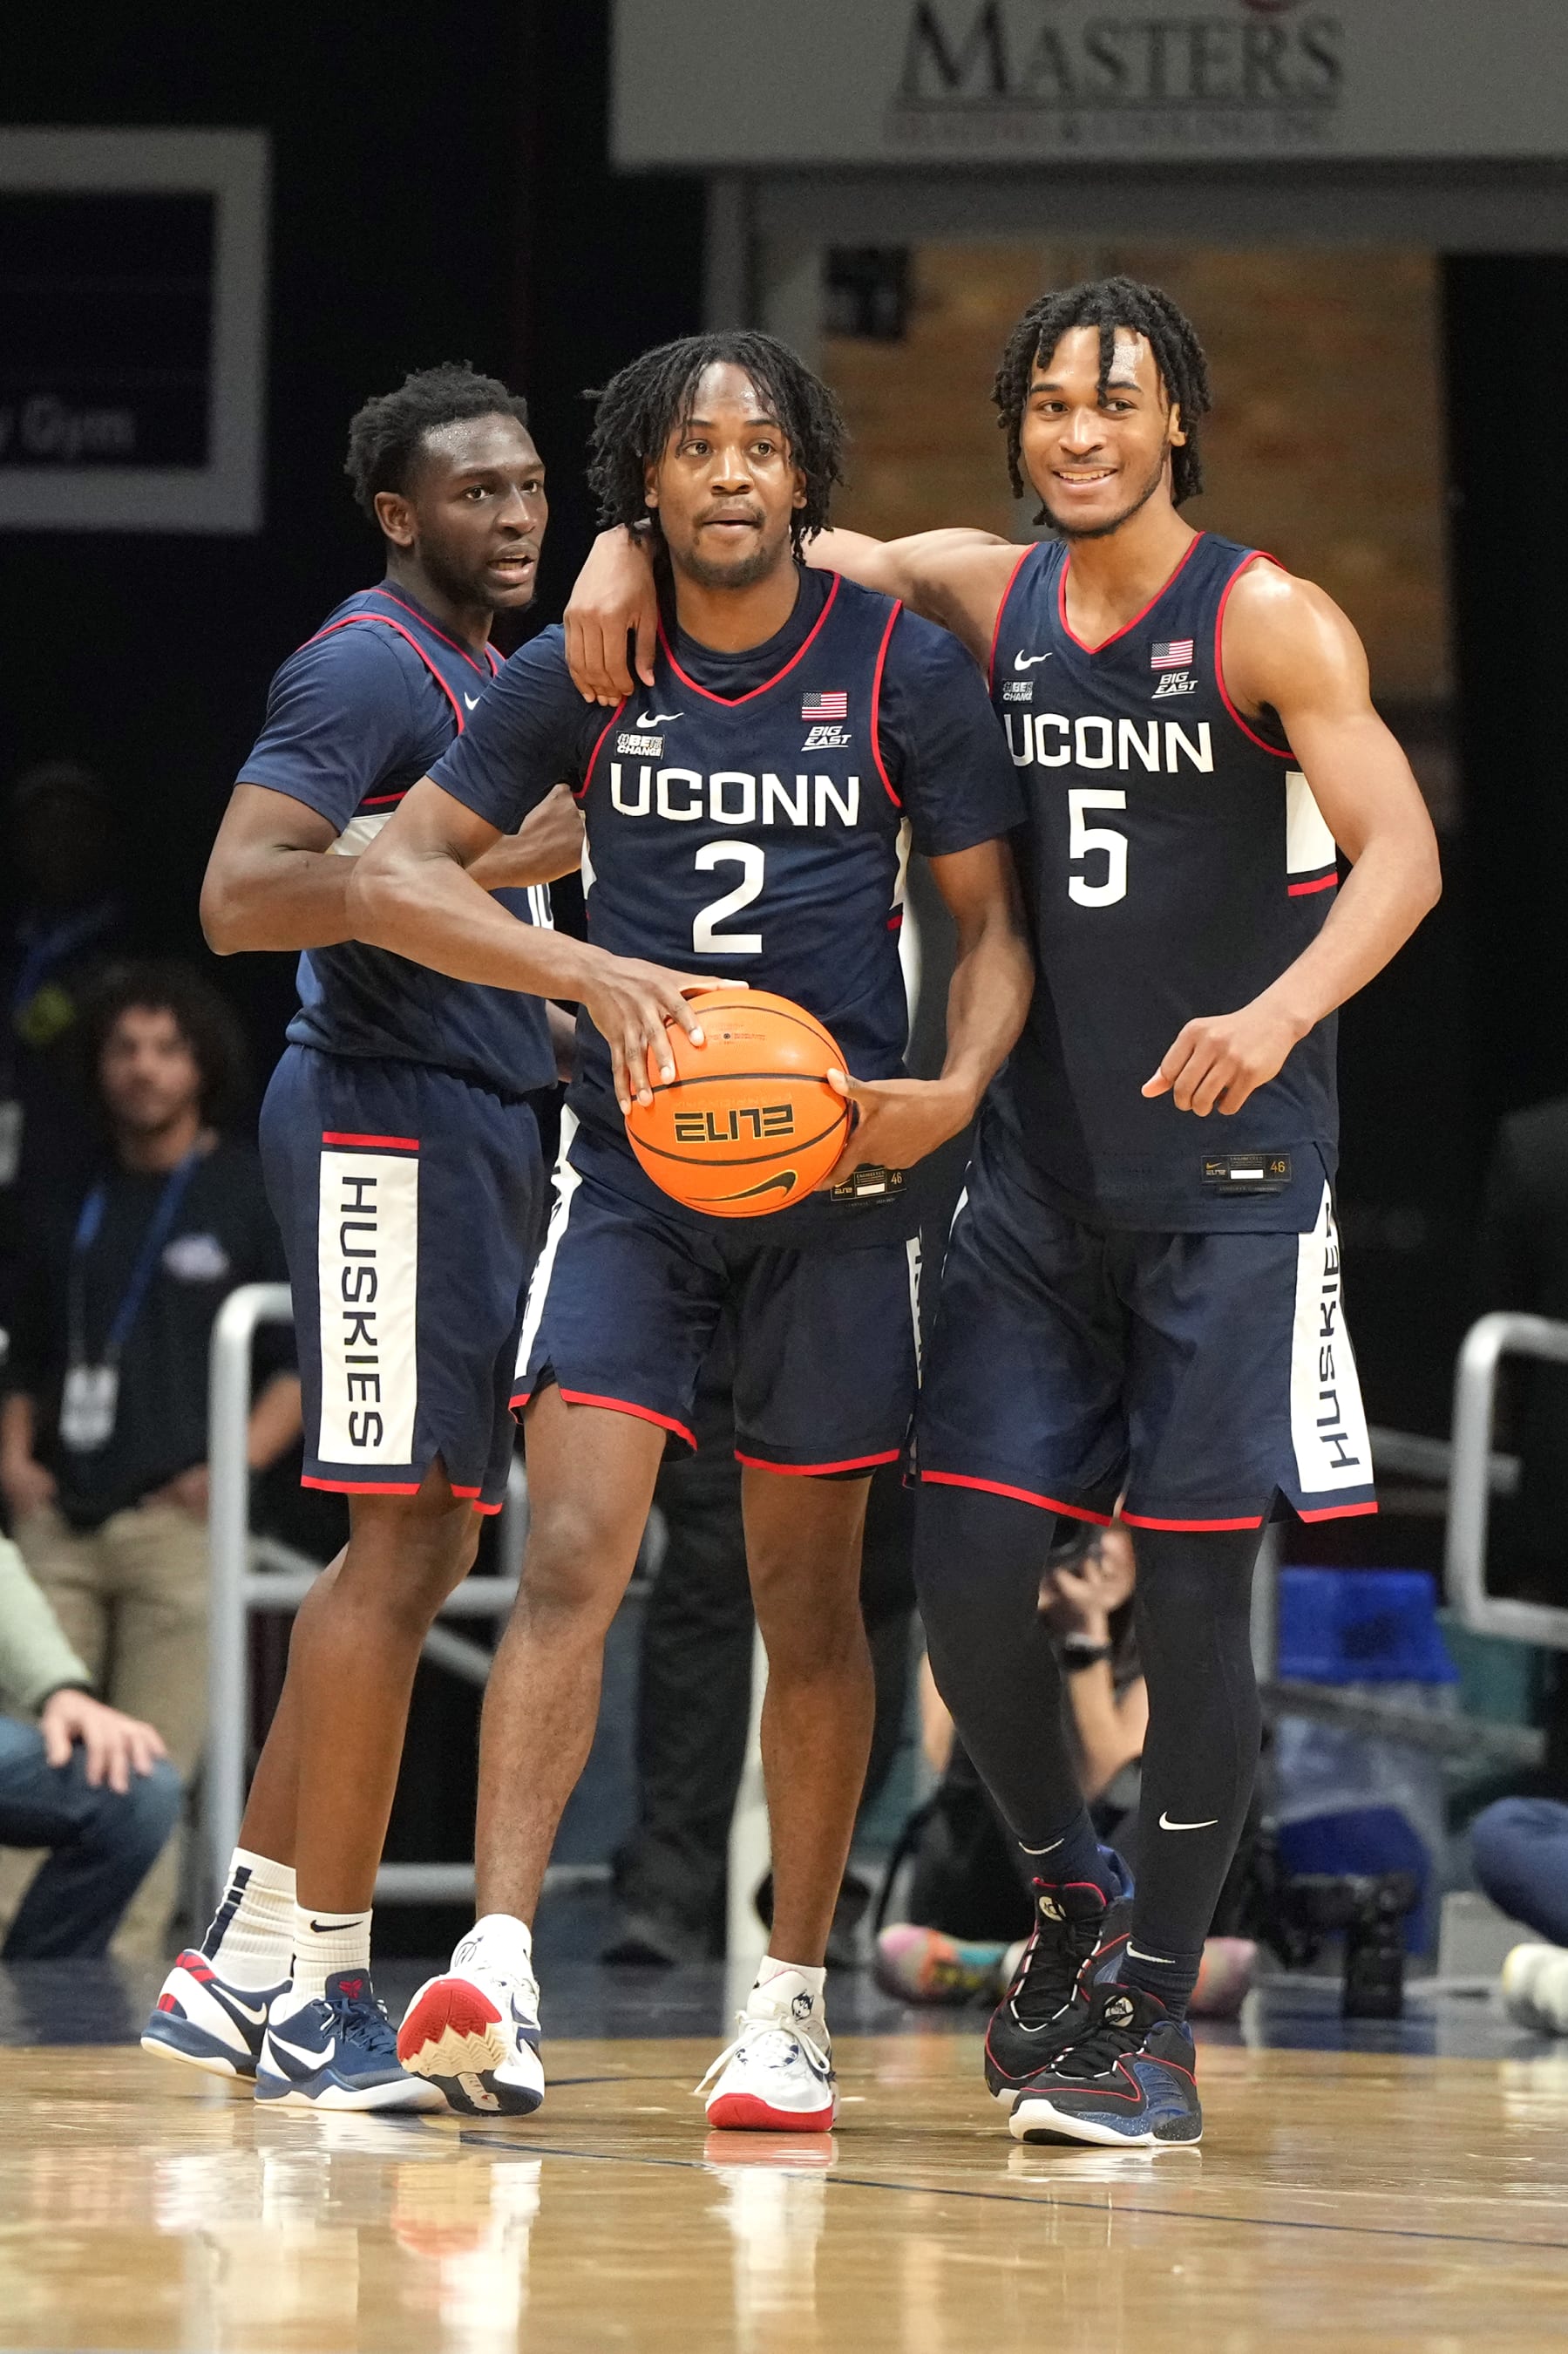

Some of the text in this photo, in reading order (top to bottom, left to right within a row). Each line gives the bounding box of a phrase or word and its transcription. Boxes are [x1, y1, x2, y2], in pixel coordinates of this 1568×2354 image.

[20, 394, 138, 459] Gym
[1155, 680, 1198, 693] EAST
[1159, 672, 1189, 684] BIG
[804, 734, 852, 747] EAST
[810, 725, 843, 736] BIG
[1003, 713, 1214, 772] UCONN
[617, 745, 662, 757] CHANGE
[610, 763, 859, 827] UCONN
[1068, 789, 1129, 908] 5
[692, 840, 765, 955] 2
[673, 1104, 795, 1144] ELITE
[891, 1172, 903, 1185] 46
[1270, 1160, 1286, 1173] 46
[339, 1175, 384, 1449] HUSKIES
